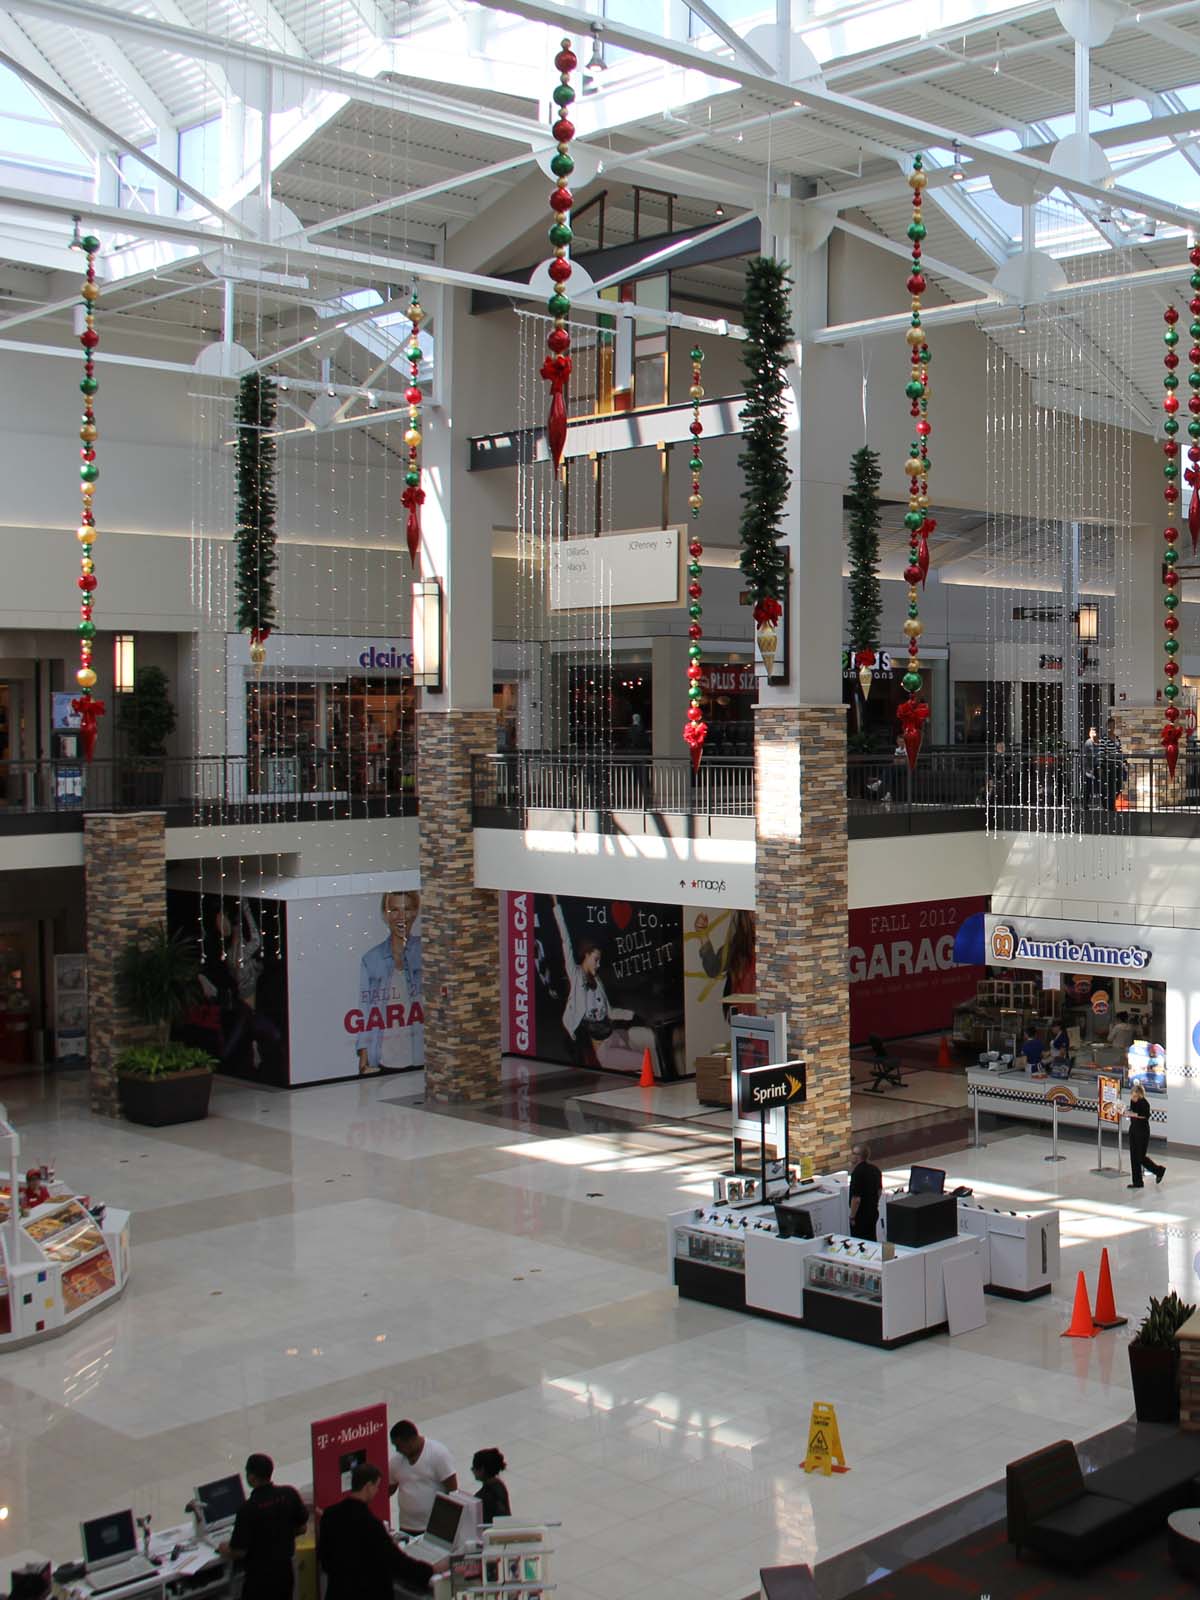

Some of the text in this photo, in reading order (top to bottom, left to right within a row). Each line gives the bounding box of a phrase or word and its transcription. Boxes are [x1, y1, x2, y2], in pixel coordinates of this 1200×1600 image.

[586, 905, 607, 924] I'd
[870, 907, 957, 934] FALL 2012
[615, 929, 652, 955] ROLL
[514, 894, 530, 1051] GARAGE.CA
[612, 942, 673, 979] WITH IT
[848, 934, 972, 983] GARAG
[343, 1001, 425, 1034] GARA
[753, 1082, 787, 1104] Sprint
